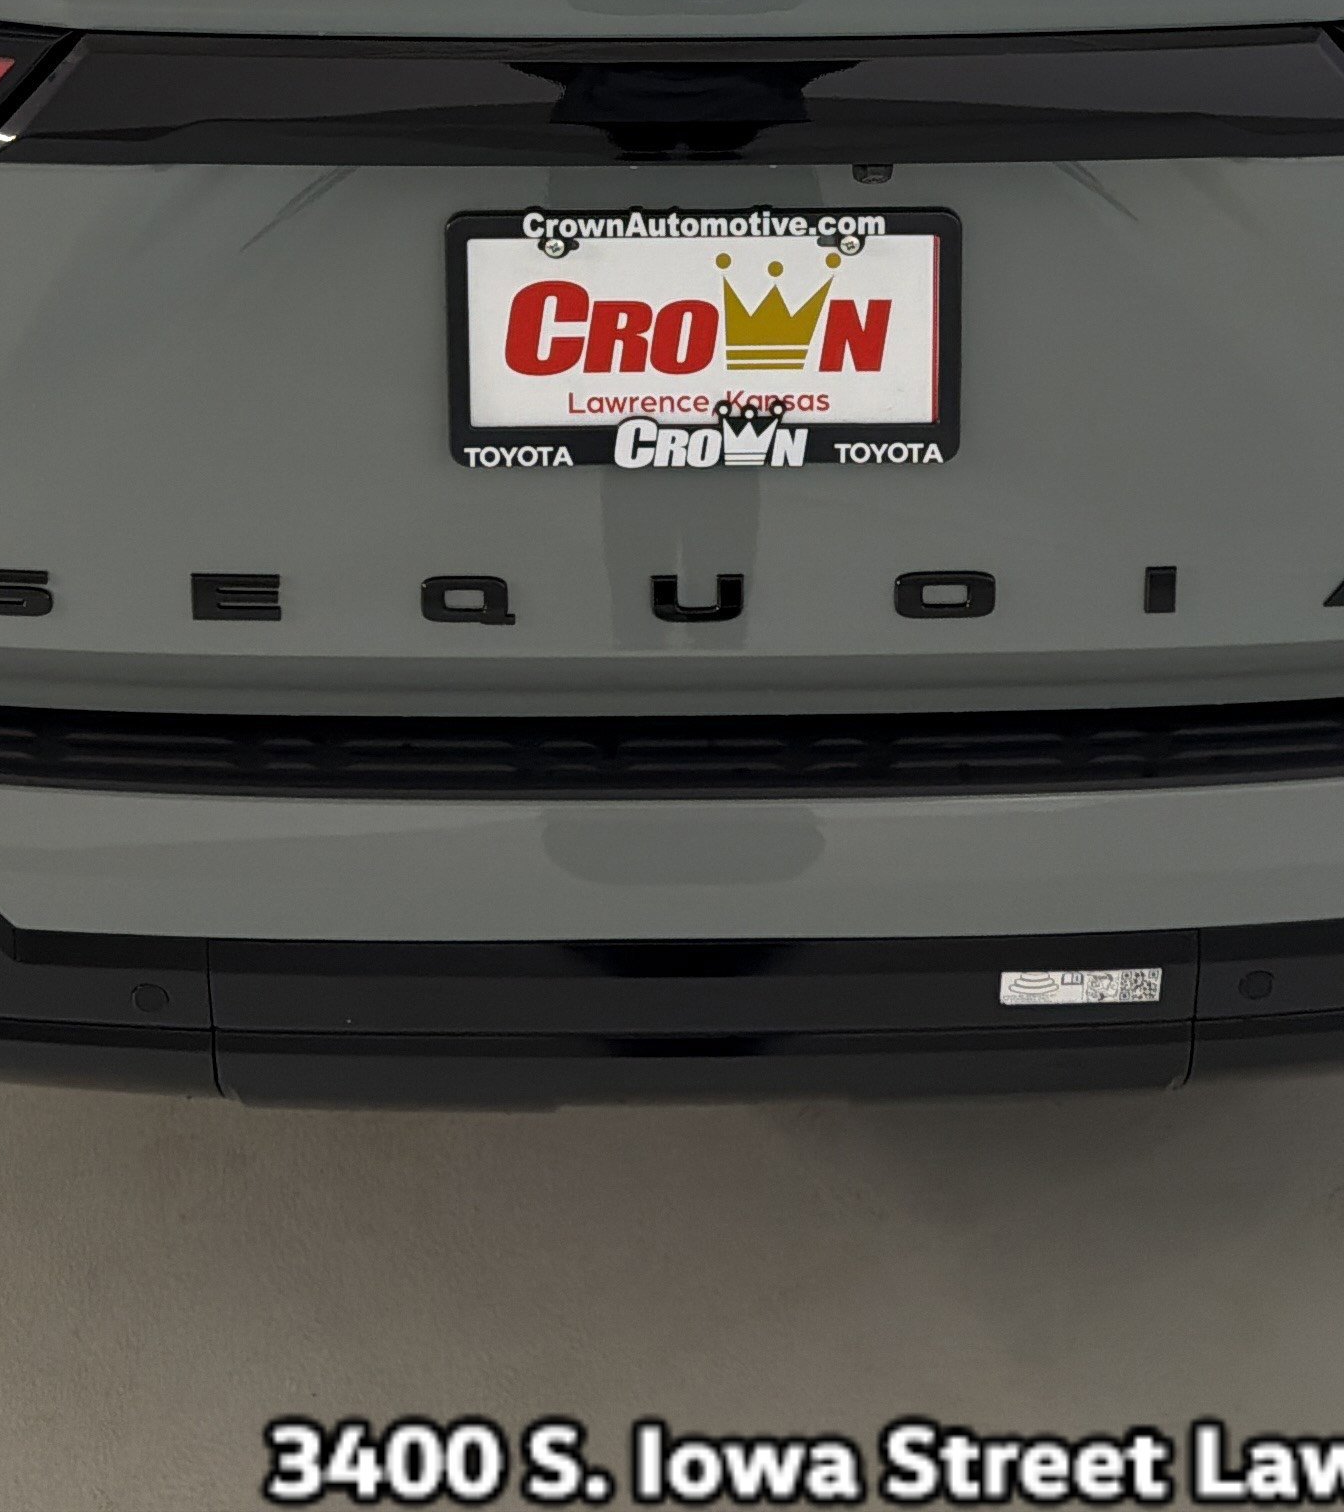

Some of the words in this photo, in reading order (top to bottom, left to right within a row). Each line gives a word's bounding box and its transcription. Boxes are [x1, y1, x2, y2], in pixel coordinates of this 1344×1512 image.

[522, 212, 886, 238] CrownAutomotive.com
[505, 254, 892, 375] CROWN
[464, 445, 574, 468] TOYOTA
[614, 402, 809, 469] CROWN
[834, 442, 944, 465] TOYOTA
